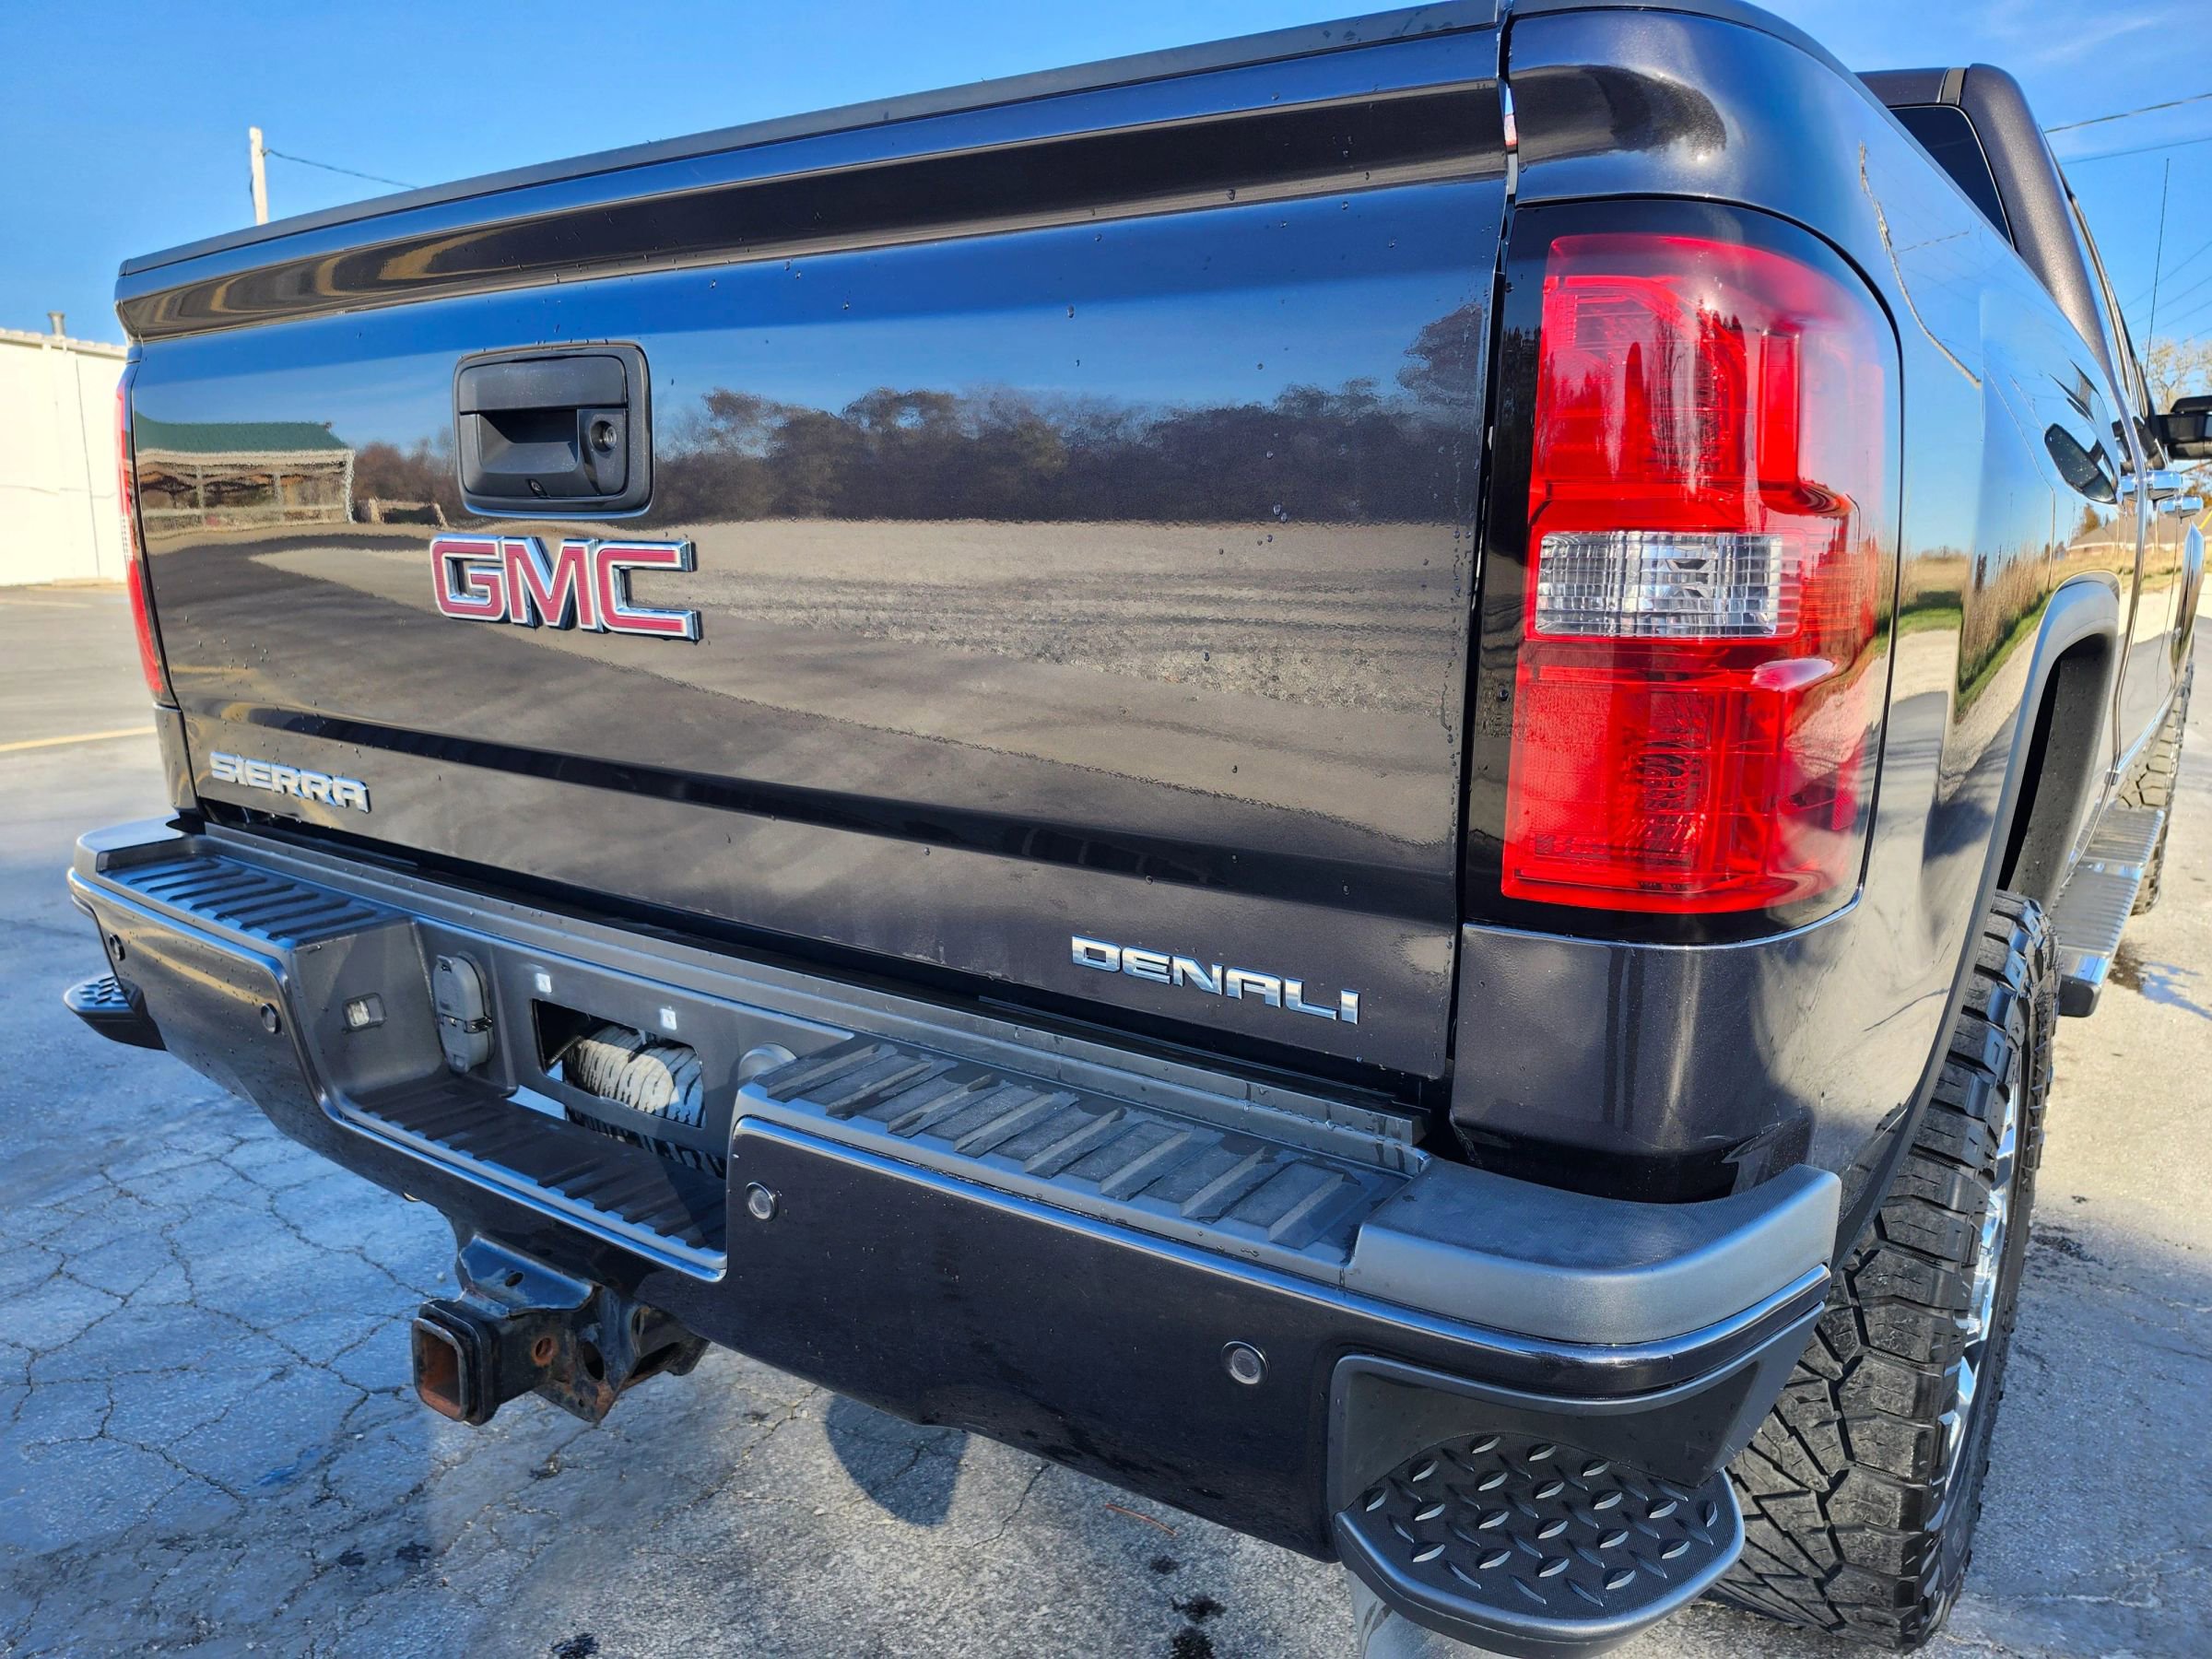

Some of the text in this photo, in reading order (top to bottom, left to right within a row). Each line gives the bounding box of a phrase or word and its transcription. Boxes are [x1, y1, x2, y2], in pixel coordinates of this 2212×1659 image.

[430, 533, 700, 641] GMC
[209, 751, 371, 814] SIERRA
[1072, 935, 1359, 1025] DENALI
